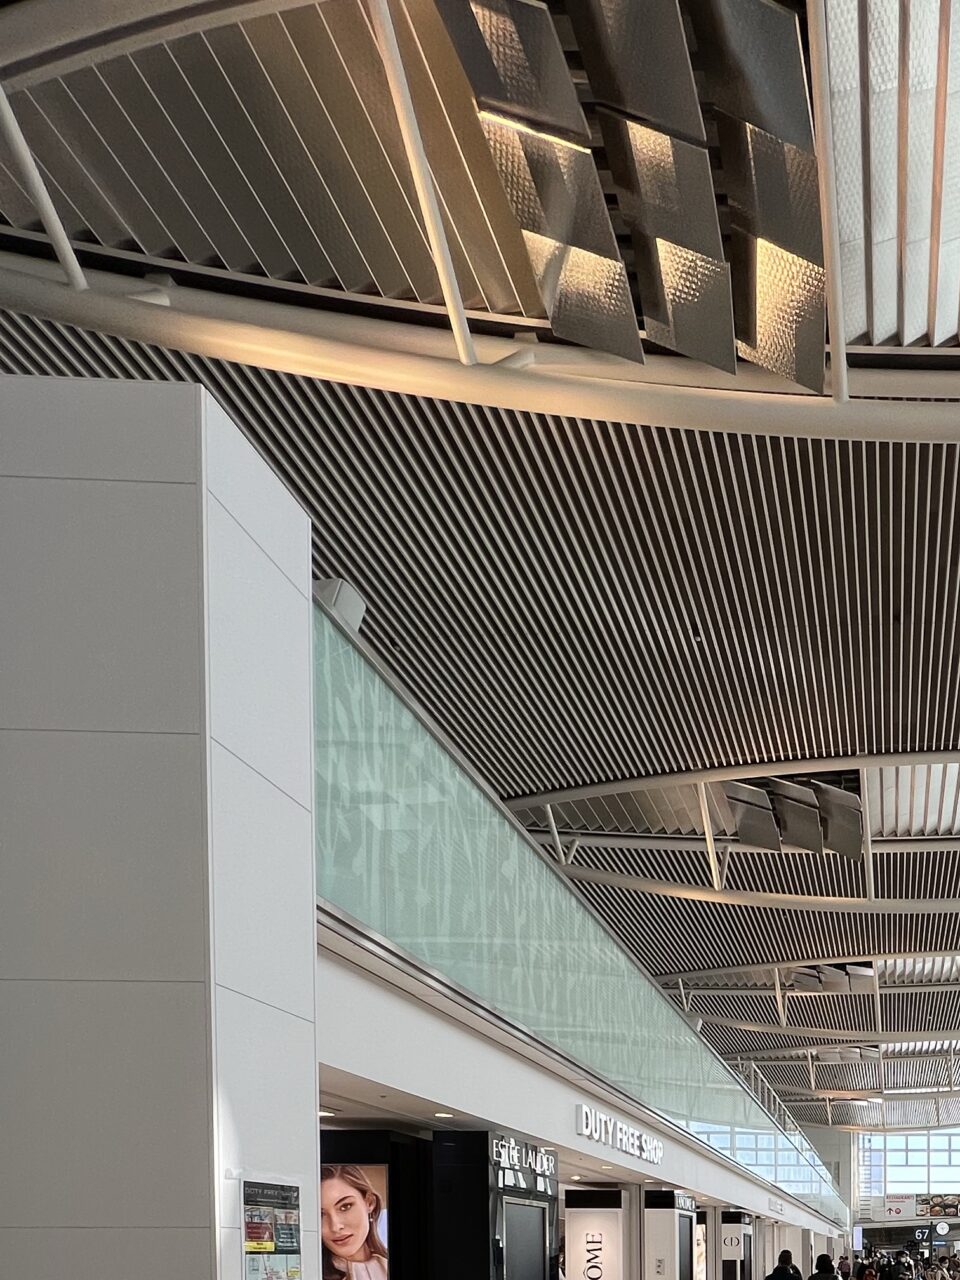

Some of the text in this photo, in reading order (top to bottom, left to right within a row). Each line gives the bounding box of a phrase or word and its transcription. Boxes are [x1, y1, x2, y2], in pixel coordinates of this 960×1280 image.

[580, 1103, 664, 1165] DUTY FREE SHOP
[522, 1147, 556, 1174] LAUDER
[915, 1229, 930, 1240] 67
